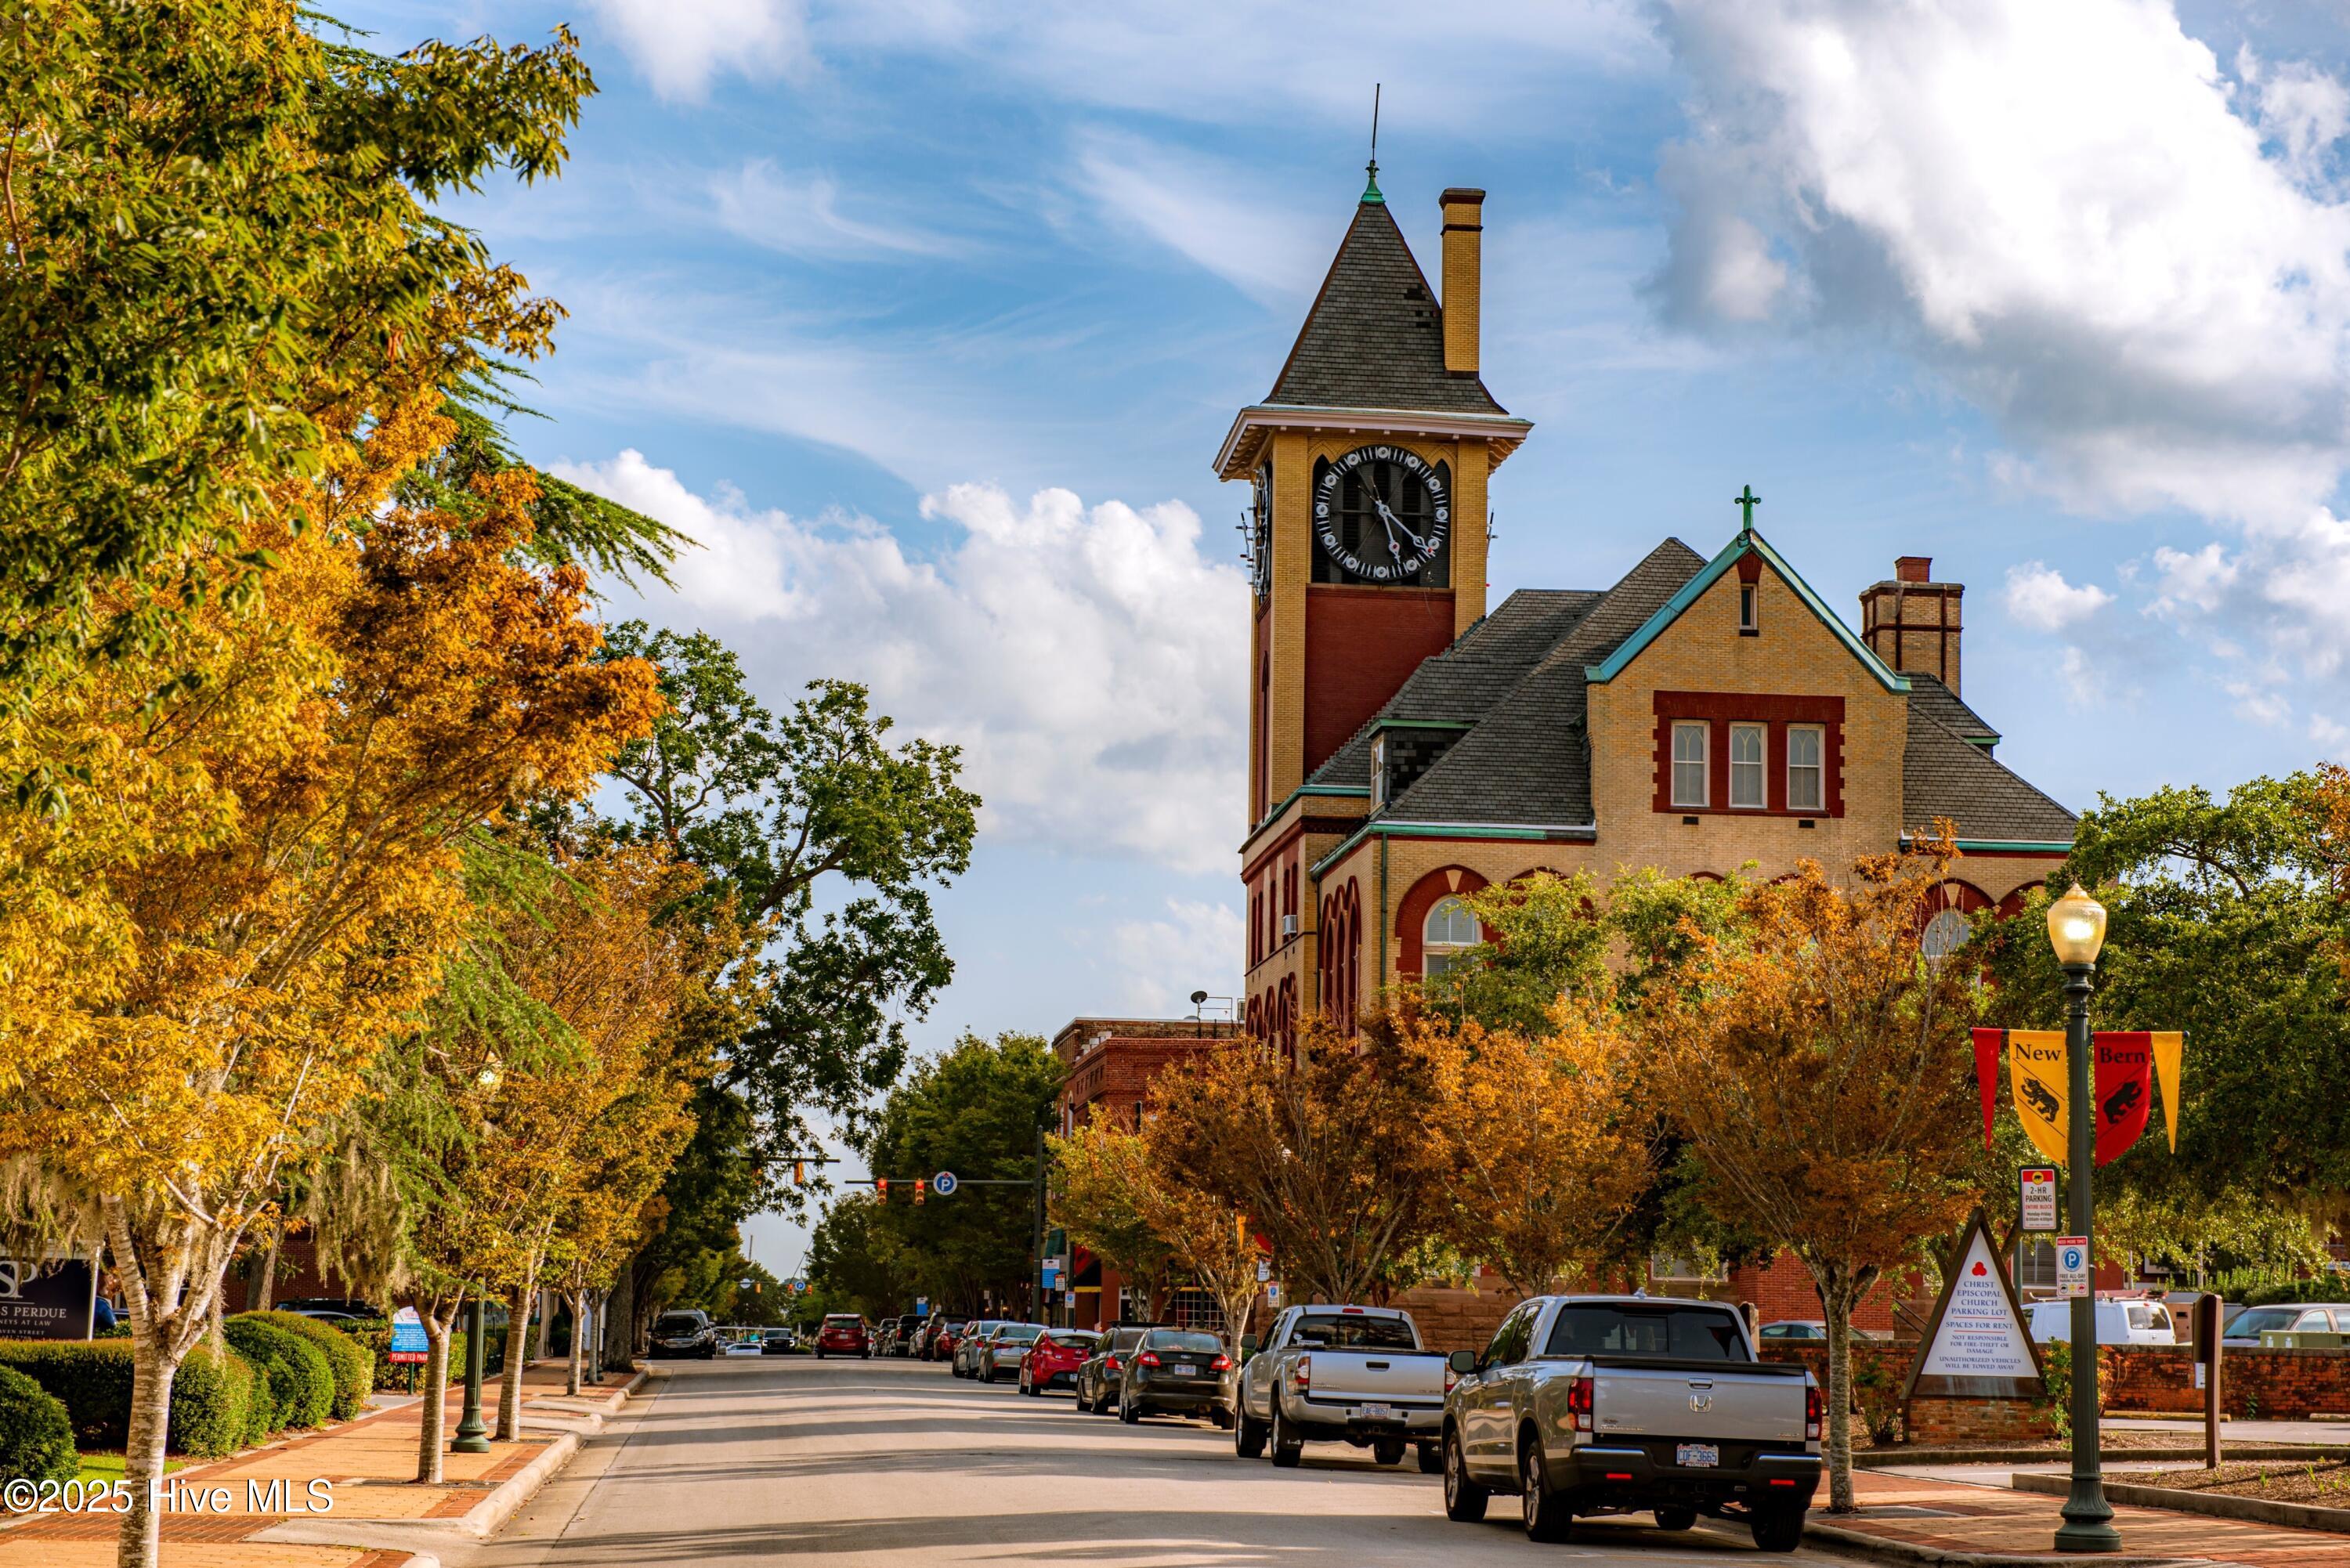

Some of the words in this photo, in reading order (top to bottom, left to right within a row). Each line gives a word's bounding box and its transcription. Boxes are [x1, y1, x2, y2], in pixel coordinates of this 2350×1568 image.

[2015, 1043, 2062, 1061] New
[2099, 1046, 2146, 1064] Bern
[942, 1179, 951, 1190] P
[2068, 1253, 2077, 1266] P
[13, 1306, 67, 1318] PERDUE
[392, 1353, 416, 1361] PERMITTED
